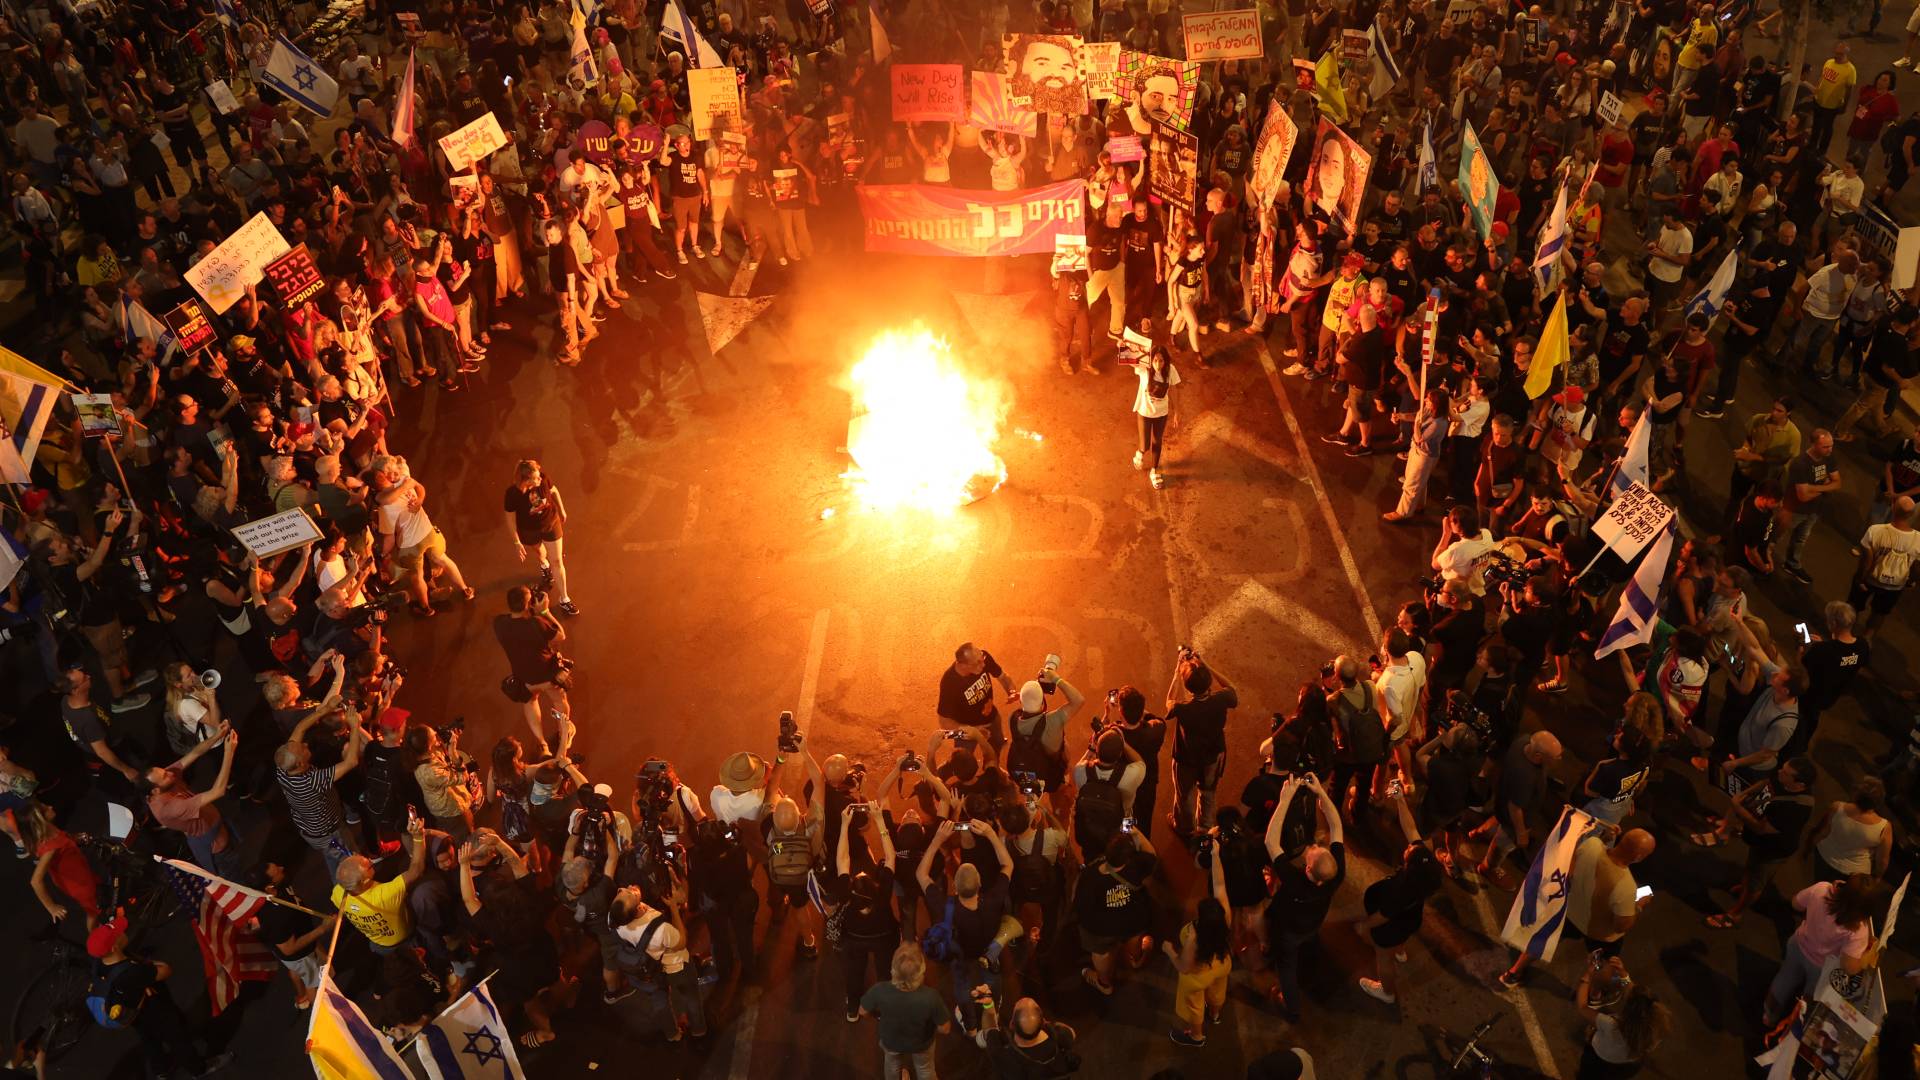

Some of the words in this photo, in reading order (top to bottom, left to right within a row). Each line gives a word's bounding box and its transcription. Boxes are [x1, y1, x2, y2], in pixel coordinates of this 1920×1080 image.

[901, 71, 926, 88] New
[932, 70, 957, 88] Day
[1606, 94, 1618, 110] דגל
[1600, 105, 1617, 122] שחור
[965, 202, 1024, 238] כל
[1026, 198, 1081, 224] קודם
[269, 253, 312, 280] ביבי
[277, 265, 317, 293] בוגד
[238, 527, 255, 536] New
[257, 522, 271, 530] day
[272, 516, 286, 525] will
[245, 535, 259, 543] and
[275, 522, 297, 533] tyrant
[251, 542, 265, 550] lost
[267, 537, 280, 545] the
[282, 532, 300, 541] prize
